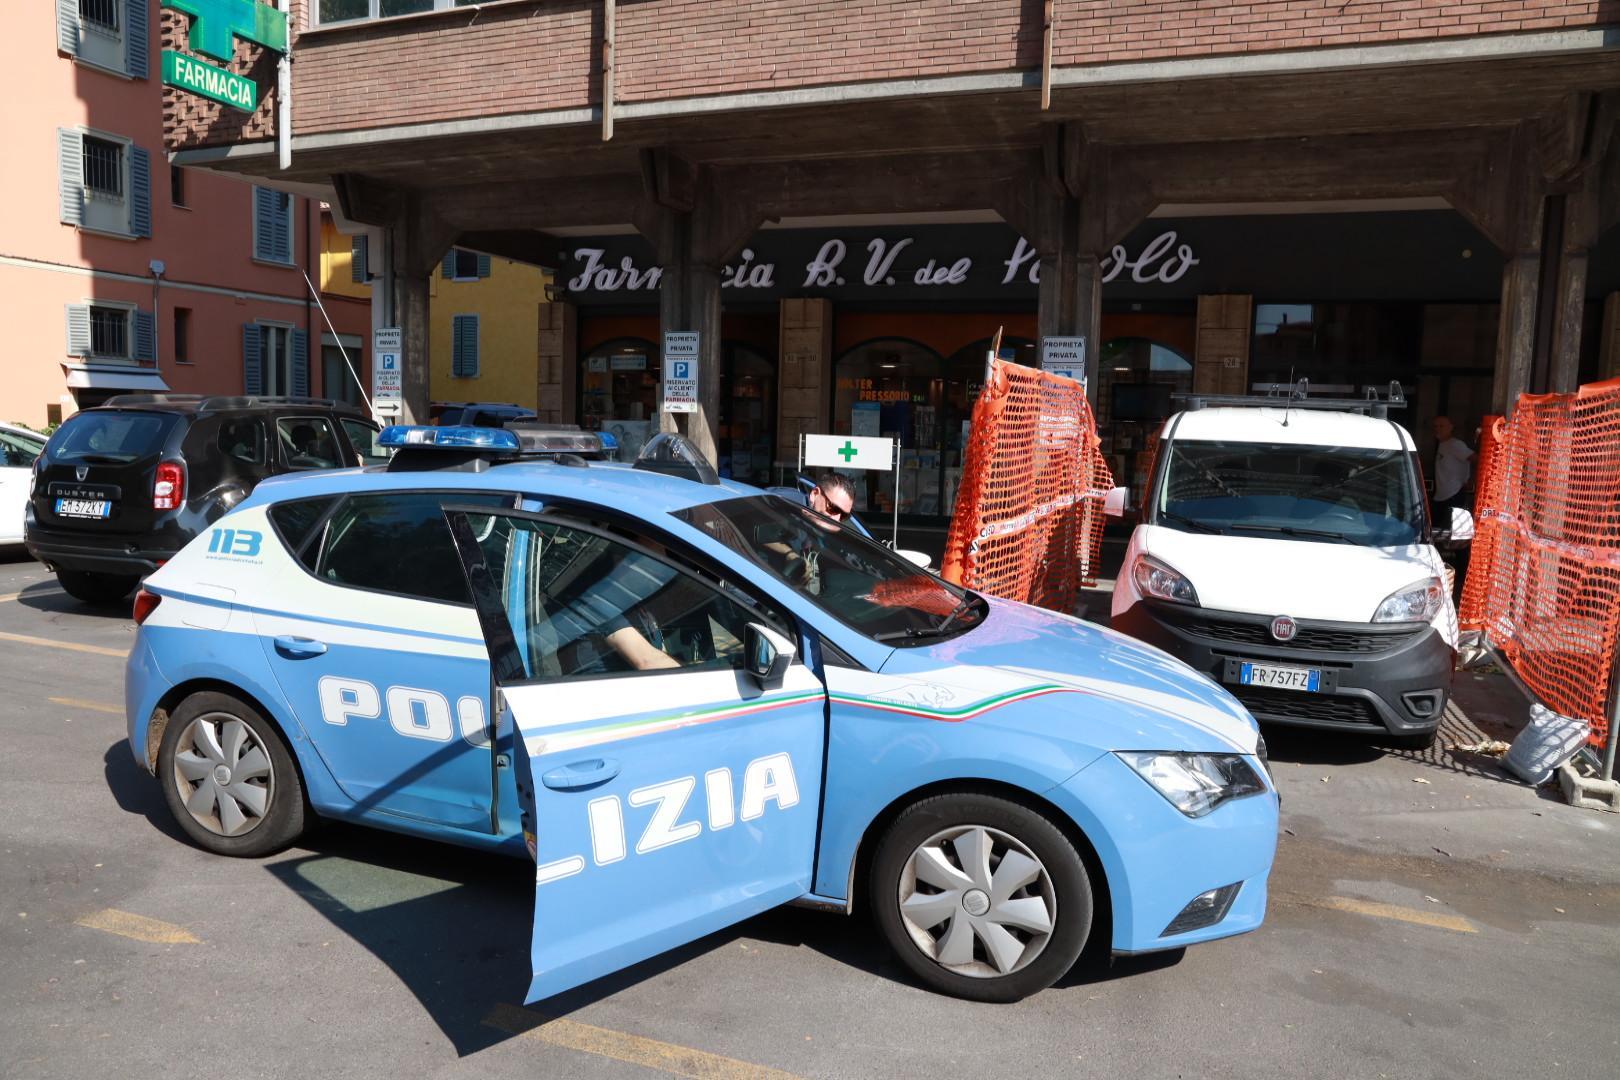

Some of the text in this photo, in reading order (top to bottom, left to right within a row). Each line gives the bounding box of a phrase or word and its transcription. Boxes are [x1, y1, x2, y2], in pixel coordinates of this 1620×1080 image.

[175, 56, 253, 108] FARMACIA
[568, 248, 776, 292] Faria
[863, 237, 914, 287] V.
[914, 257, 973, 286] del
[1001, 230, 1201, 284] Polo
[859, 390, 910, 401] PRESSORIO
[56, 489, 105, 498] DUSTER
[207, 528, 263, 557] 113
[1276, 623, 1291, 635] FIAT
